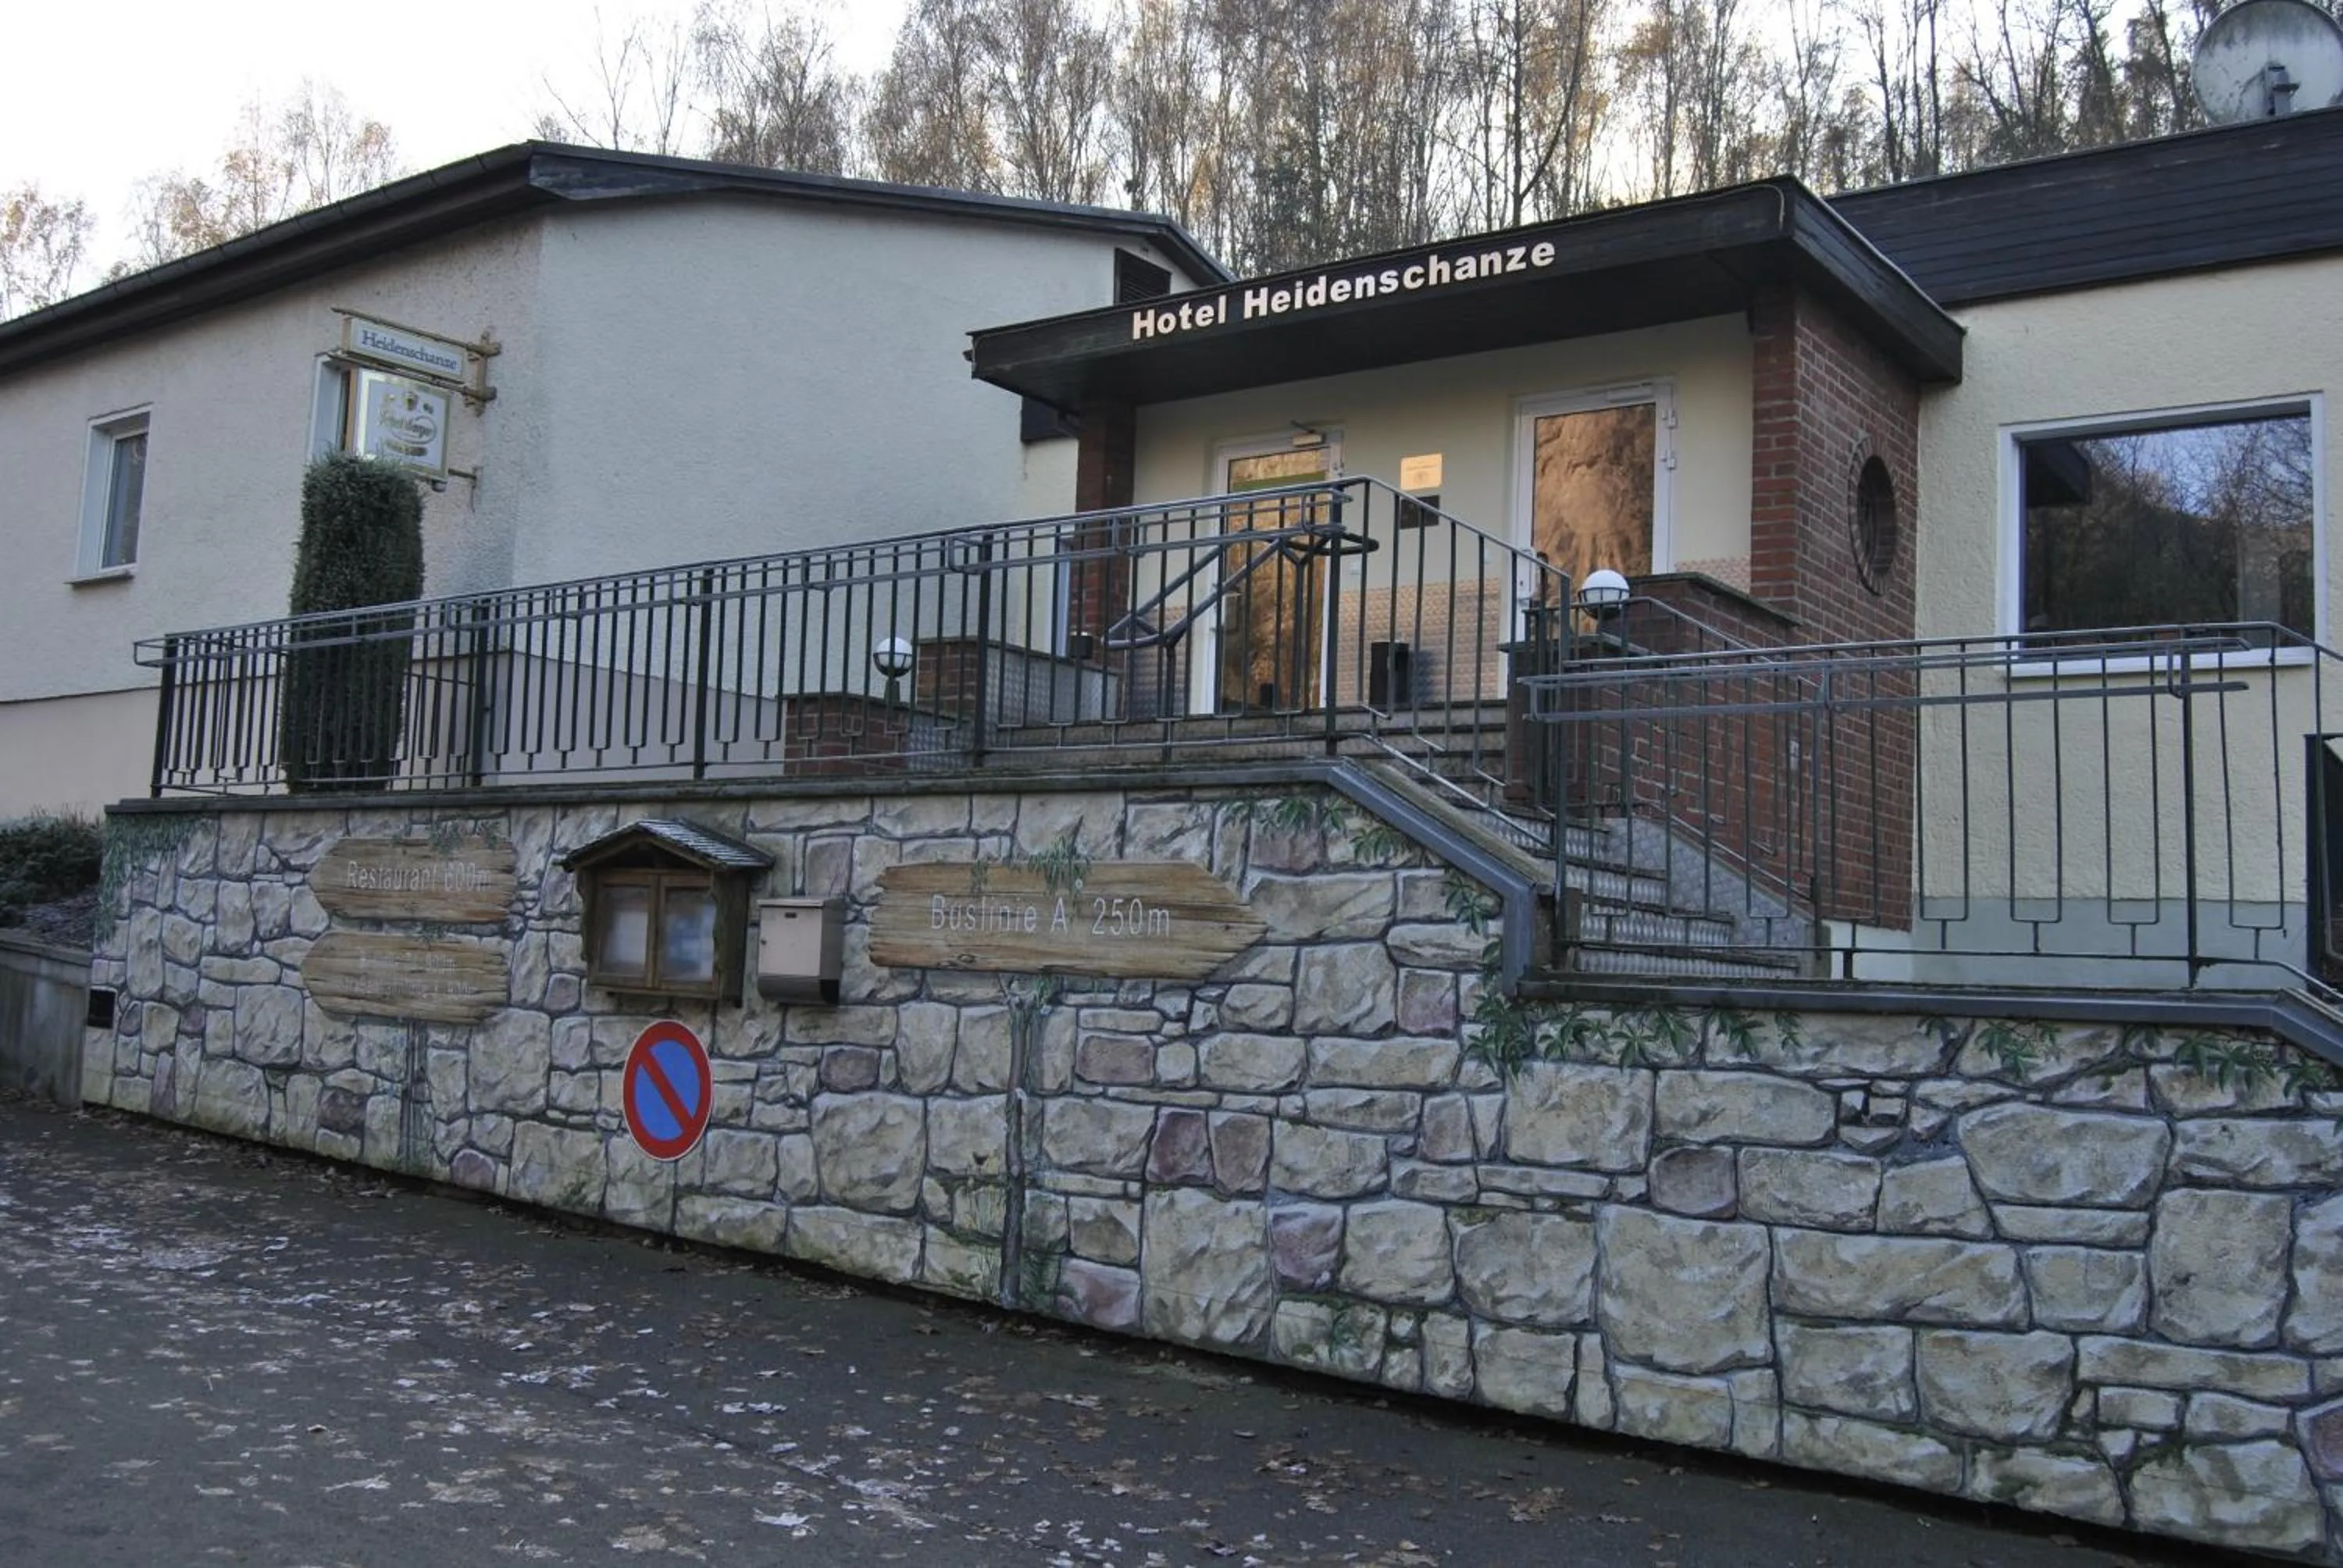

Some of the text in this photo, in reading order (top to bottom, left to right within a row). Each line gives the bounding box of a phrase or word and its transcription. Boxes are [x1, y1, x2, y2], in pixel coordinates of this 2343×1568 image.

[1132, 241, 1557, 339] Hotel Heidenschanze
[362, 330, 458, 370] Heidenschanze
[347, 861, 438, 891] Restaurant
[930, 893, 1170, 936] Buslinie A 250m
